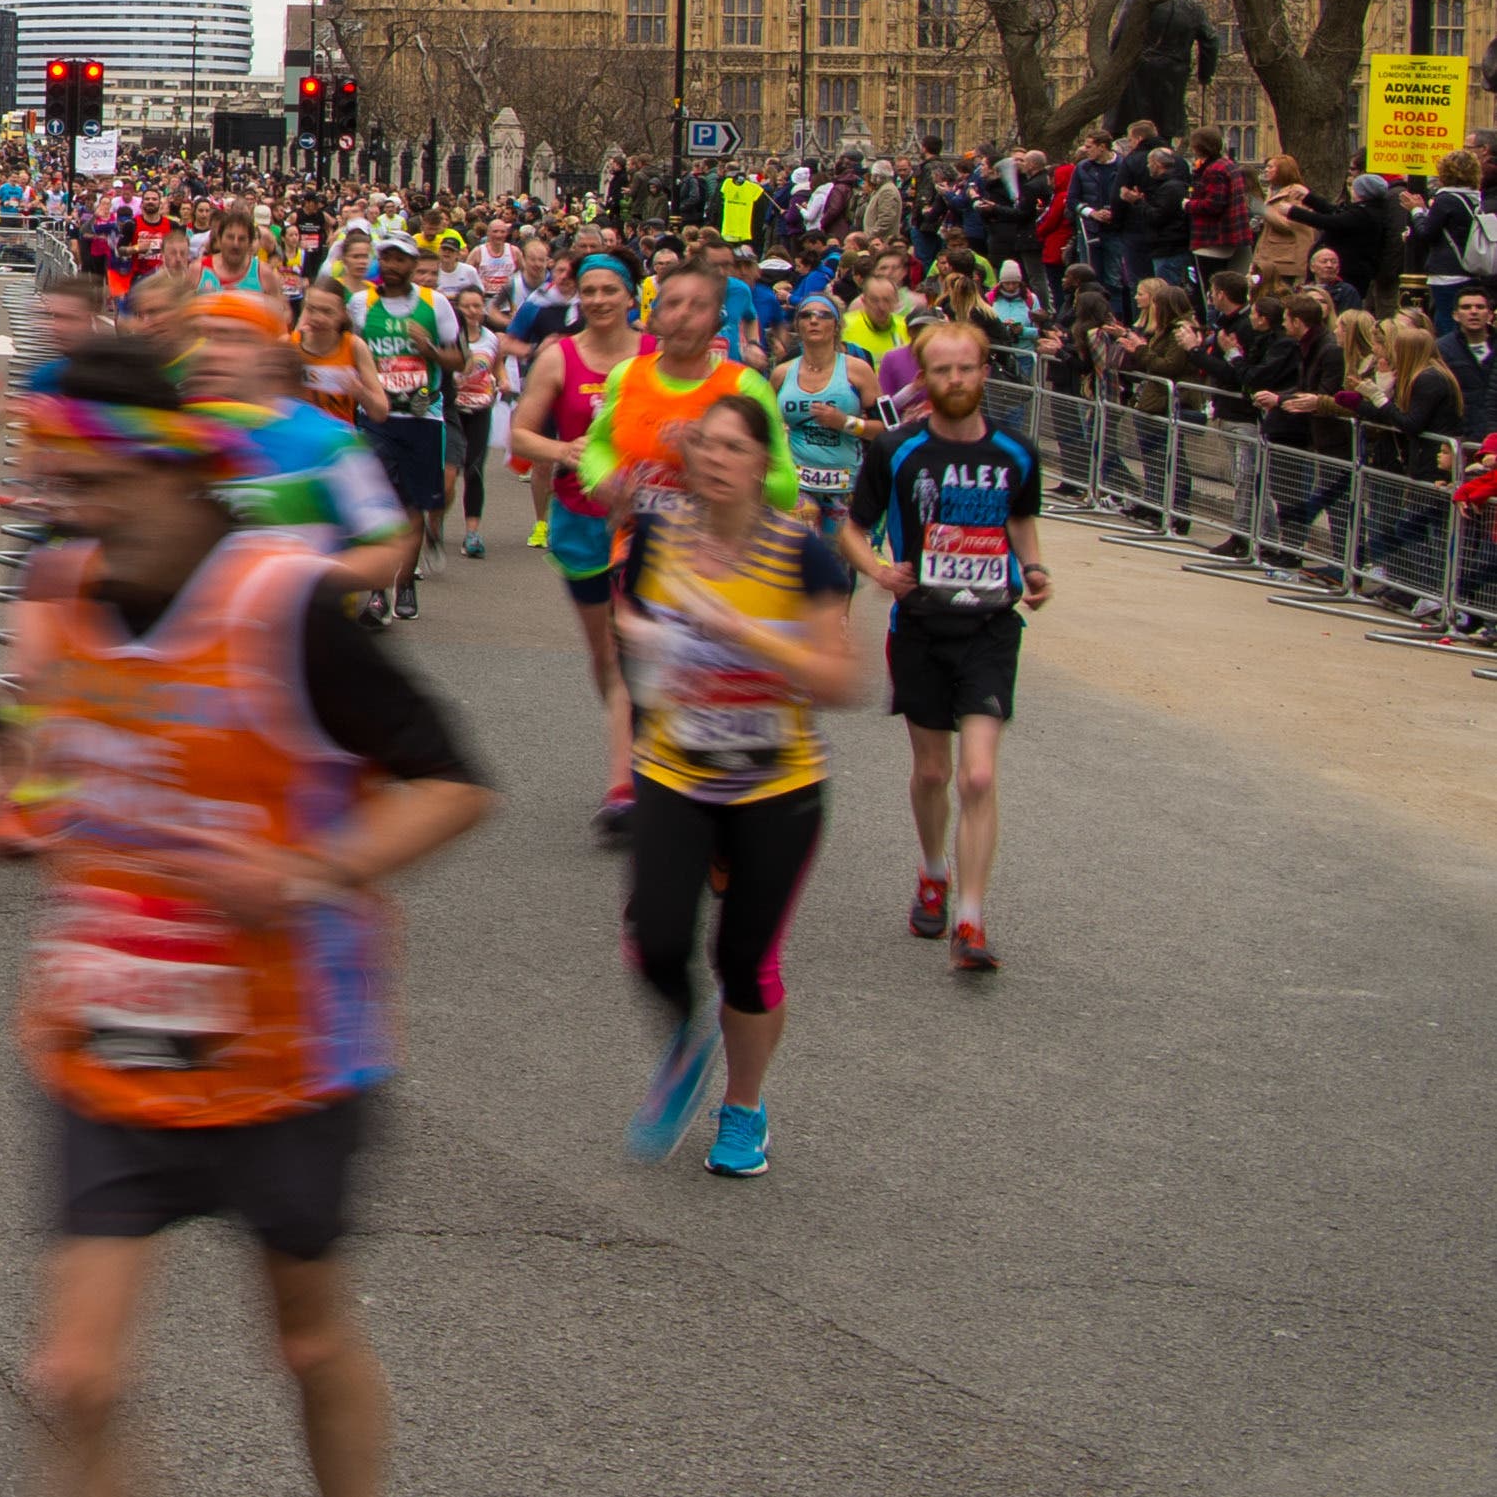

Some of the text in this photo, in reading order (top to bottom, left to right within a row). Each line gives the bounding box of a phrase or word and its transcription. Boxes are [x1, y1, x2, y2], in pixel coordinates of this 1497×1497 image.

[1385, 83, 1451, 95] ADVANCE
[1384, 95, 1450, 106] WARNING
[1394, 111, 1438, 122] ROAD
[698, 126, 713, 144] P
[1383, 125, 1448, 137] CLOSED
[1374, 140, 1408, 148] SUNDAY
[1374, 153, 1399, 162] 07:00
[1402, 154, 1427, 163] UNTIL
[785, 400, 837, 413] DE
[801, 469, 841, 486] 5441
[942, 464, 1009, 490] ALEX
[964, 535, 1005, 551] money
[926, 555, 1004, 581] 13379
